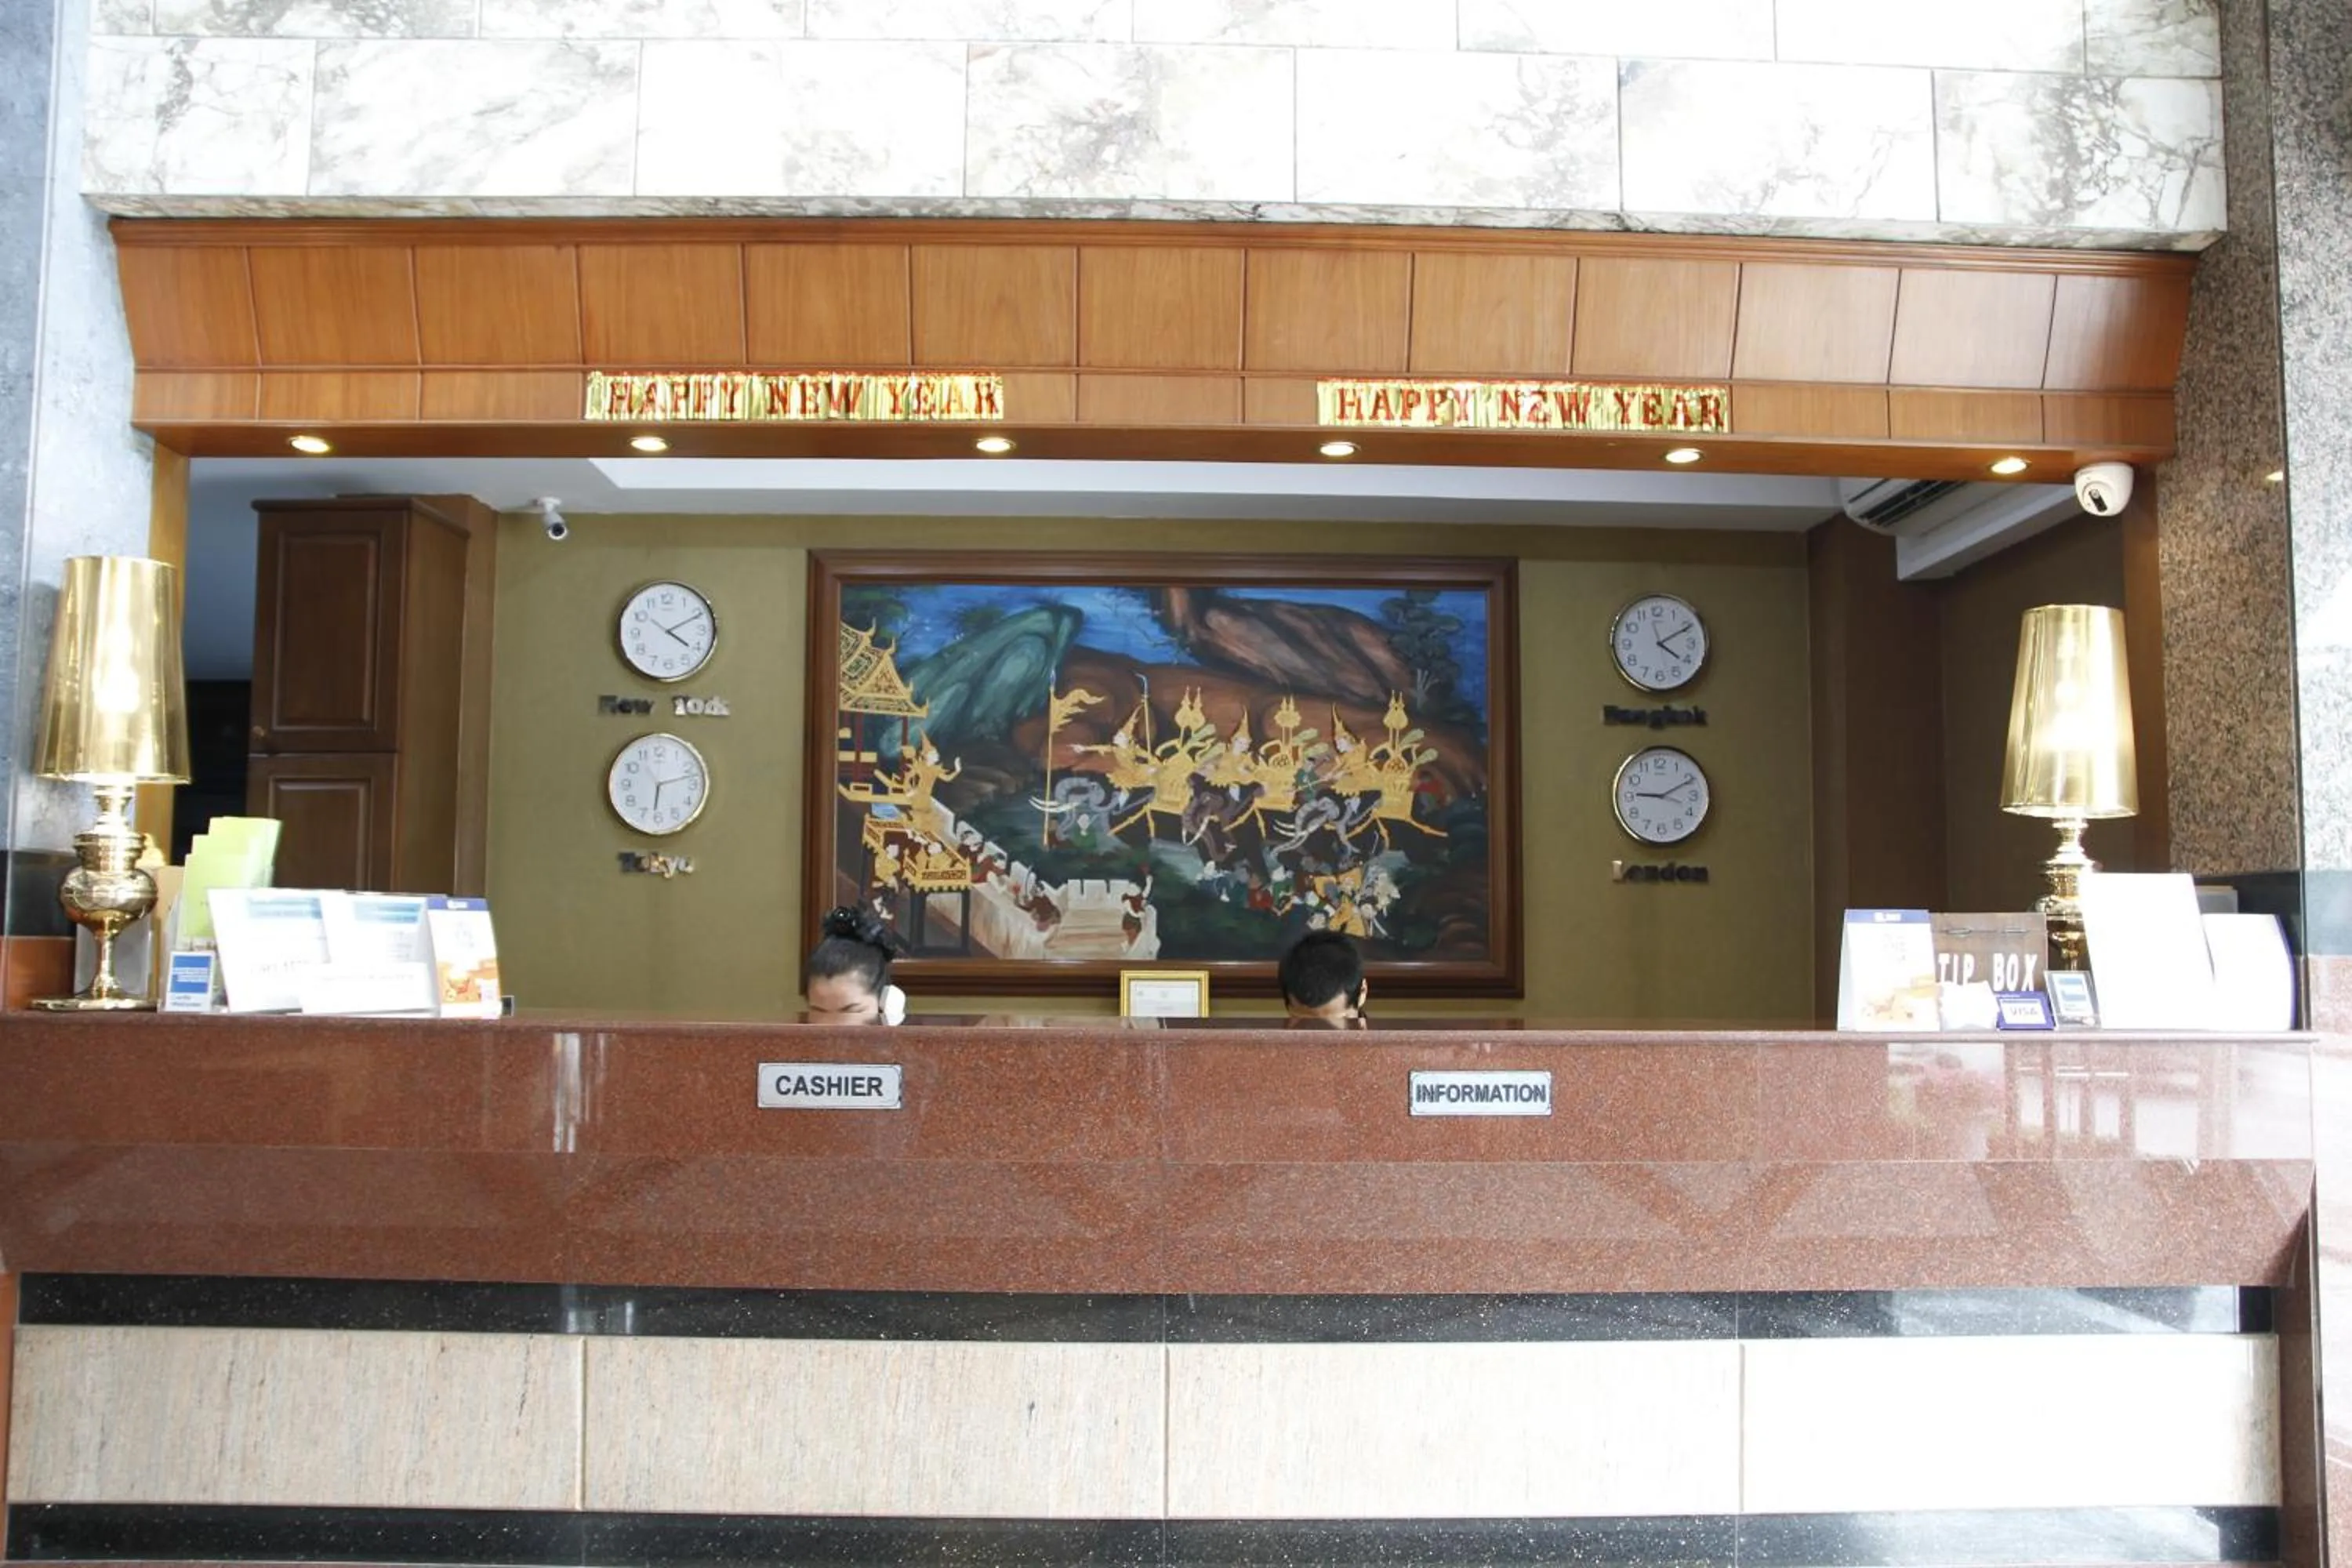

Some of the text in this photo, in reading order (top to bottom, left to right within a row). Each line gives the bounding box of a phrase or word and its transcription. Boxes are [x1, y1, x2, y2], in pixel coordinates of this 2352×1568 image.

[608, 376, 741, 416] HAPPY
[1337, 387, 1475, 422] HAPPY
[1613, 393, 1724, 426] YEAR
[1937, 953, 2038, 992] TIP BOX
[2009, 1007, 2038, 1016] VISA
[775, 1075, 884, 1097] CASHIER
[1415, 1083, 1548, 1104] INFORMATION
